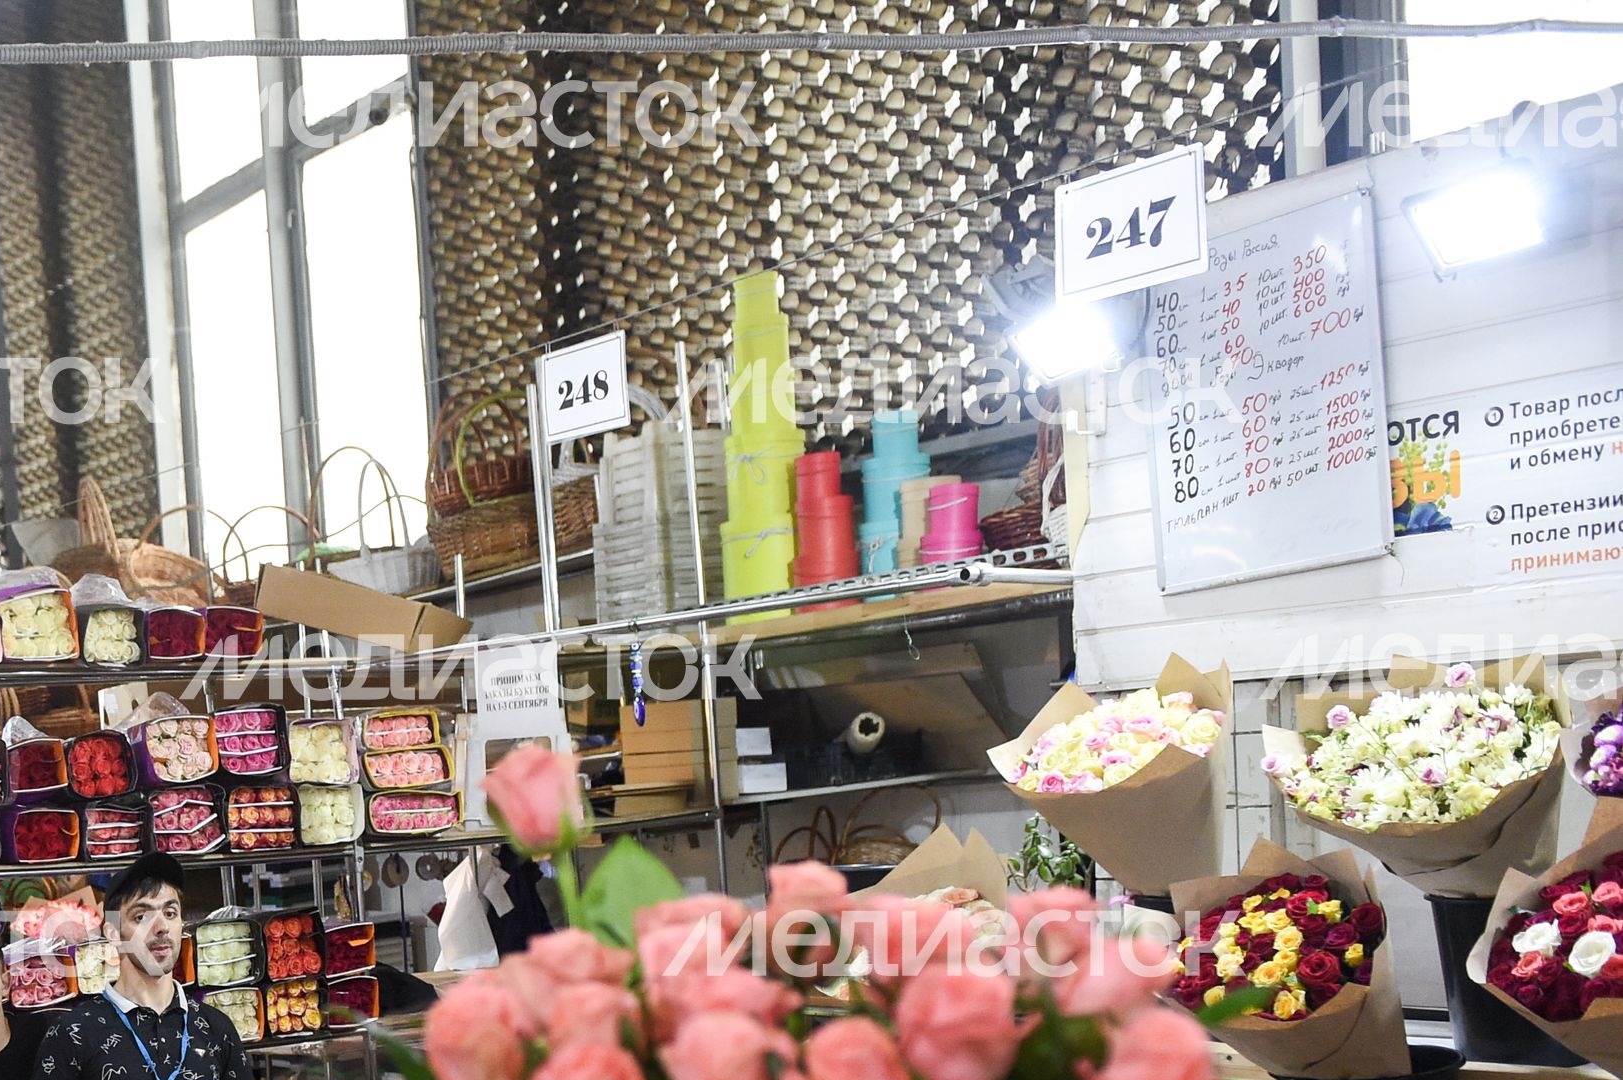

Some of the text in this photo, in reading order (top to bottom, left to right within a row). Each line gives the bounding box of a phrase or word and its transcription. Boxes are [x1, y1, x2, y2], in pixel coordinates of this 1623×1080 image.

[1086, 195, 1177, 260] 247
[1156, 292, 1179, 313] 40
[1293, 245, 1327, 275] 350
[1154, 313, 1176, 335] 50
[1222, 298, 1241, 318] 40
[1156, 333, 1179, 358] 60
[1221, 317, 1240, 336] 50
[1292, 282, 1325, 304] 500
[1225, 334, 1245, 355] 60
[1294, 294, 1327, 318] 600
[1310, 307, 1351, 341] 700
[558, 369, 609, 410] 248
[1242, 392, 1267, 416] 50
[1510, 397, 1570, 420] Товар
[1169, 390, 1359, 453] 60 60 1500
[1171, 453, 1194, 478] 70
[1244, 435, 1269, 457] 70
[1174, 476, 1199, 503] 80
[1245, 457, 1270, 478] 80
[1327, 428, 1362, 452] 2000
[1248, 479, 1265, 497] 20
[1326, 446, 1364, 471] 1000
[1509, 457, 1521, 470] и
[1528, 442, 1605, 470] обмену
[1511, 526, 1571, 546] после
[490, 673, 541, 686] ПРИНИМАЕМ
[486, 702, 497, 712] НА
[508, 698, 548, 710] СЕНТЯБРЯ
